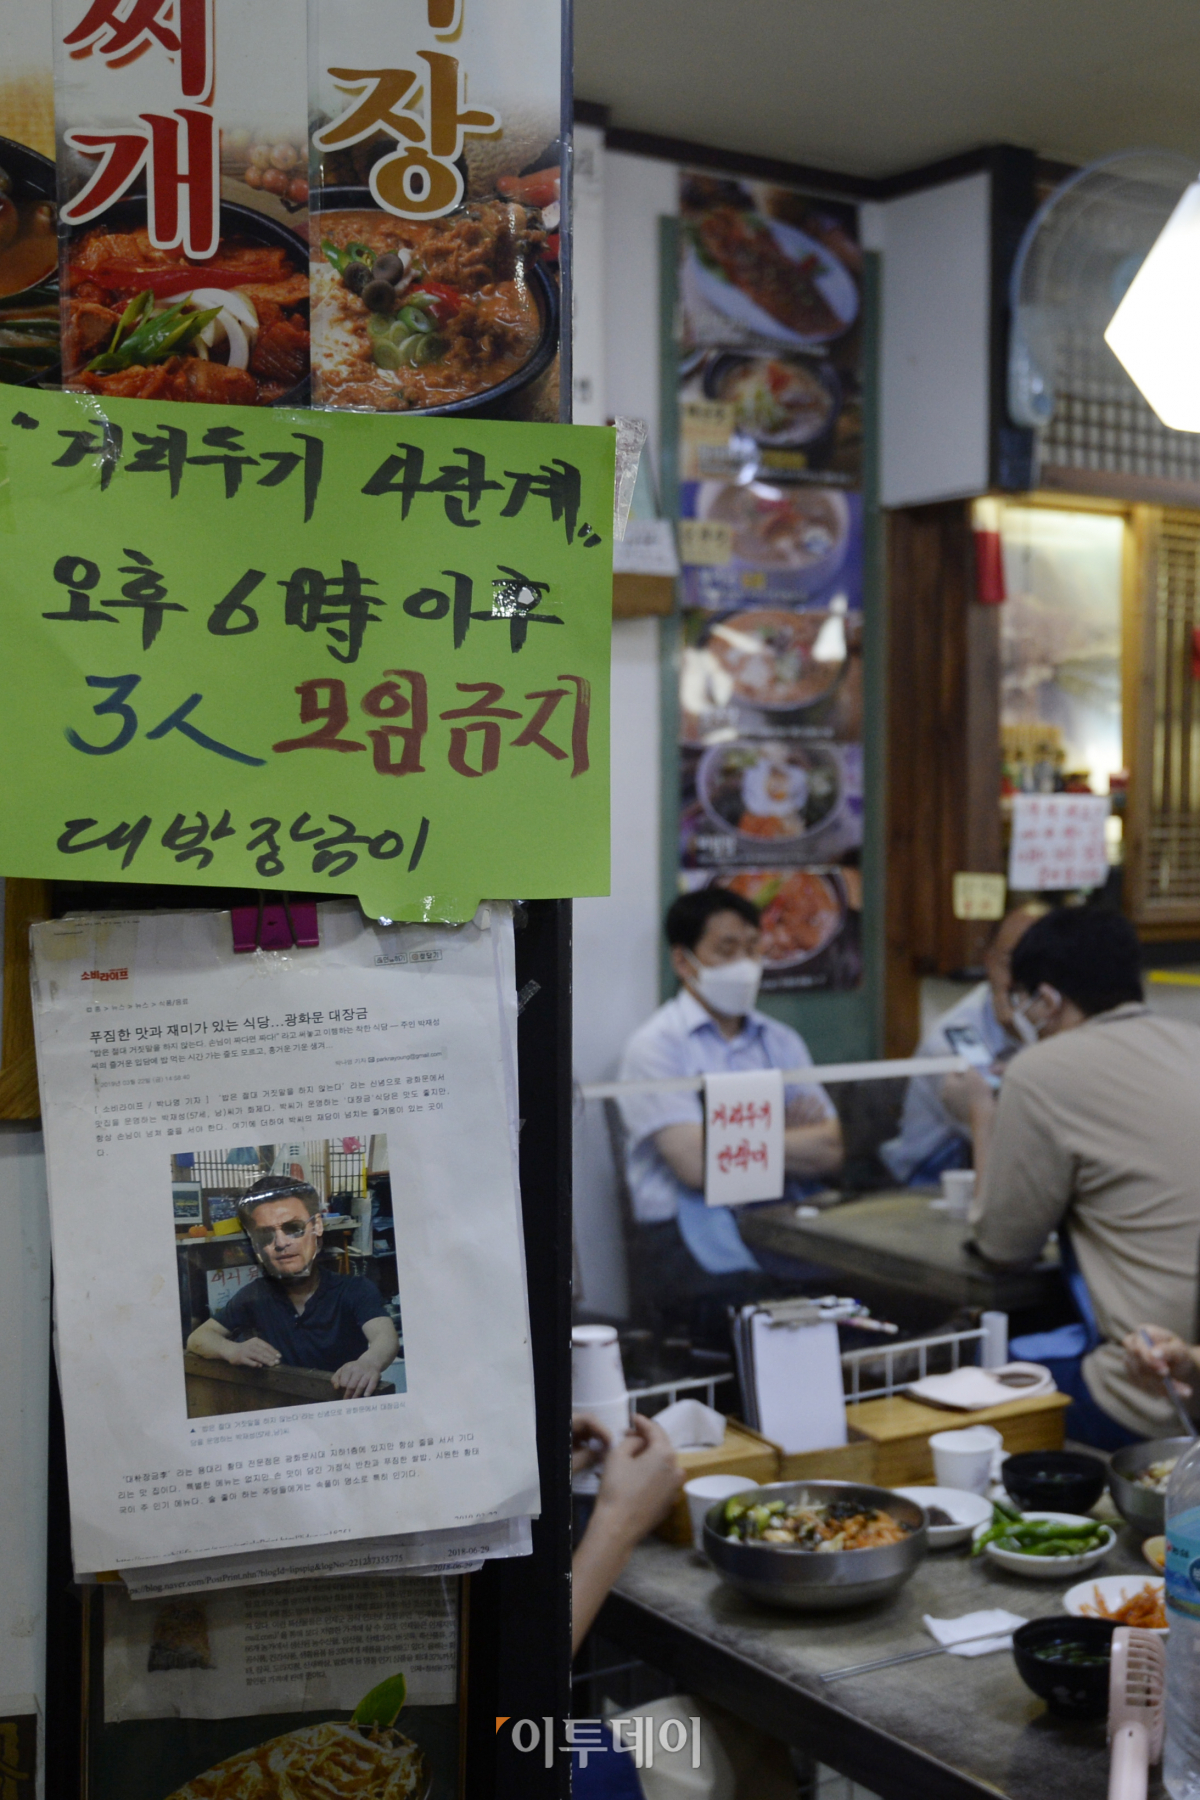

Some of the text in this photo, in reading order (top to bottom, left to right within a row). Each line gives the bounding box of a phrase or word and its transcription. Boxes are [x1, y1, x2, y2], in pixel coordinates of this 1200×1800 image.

[314, 0, 500, 219] 장
[41, 548, 188, 652] 오후
[271, 668, 592, 779] 모임금지
[81, 968, 129, 982] 소비라이프
[89, 1028, 131, 1043] 푸짐한
[135, 1025, 162, 1040] 맛과
[166, 1021, 208, 1036] 재미가
[211, 1019, 238, 1032] 있는
[328, 1007, 368, 1021] 대장금
[102, 1102, 143, 1112] 소비라이프
[185, 1096, 201, 1104] 기자
[242, 1091, 258, 1100] 절대
[262, 1087, 294, 1097] 거짓말을
[298, 1085, 314, 1094] 하지
[349, 1081, 365, 1089] 라는
[370, 1077, 401, 1087] 신념으로
[405, 1074, 444, 1084] 광화문에서
[448, 1546, 490, 1557] 2018-06-29
